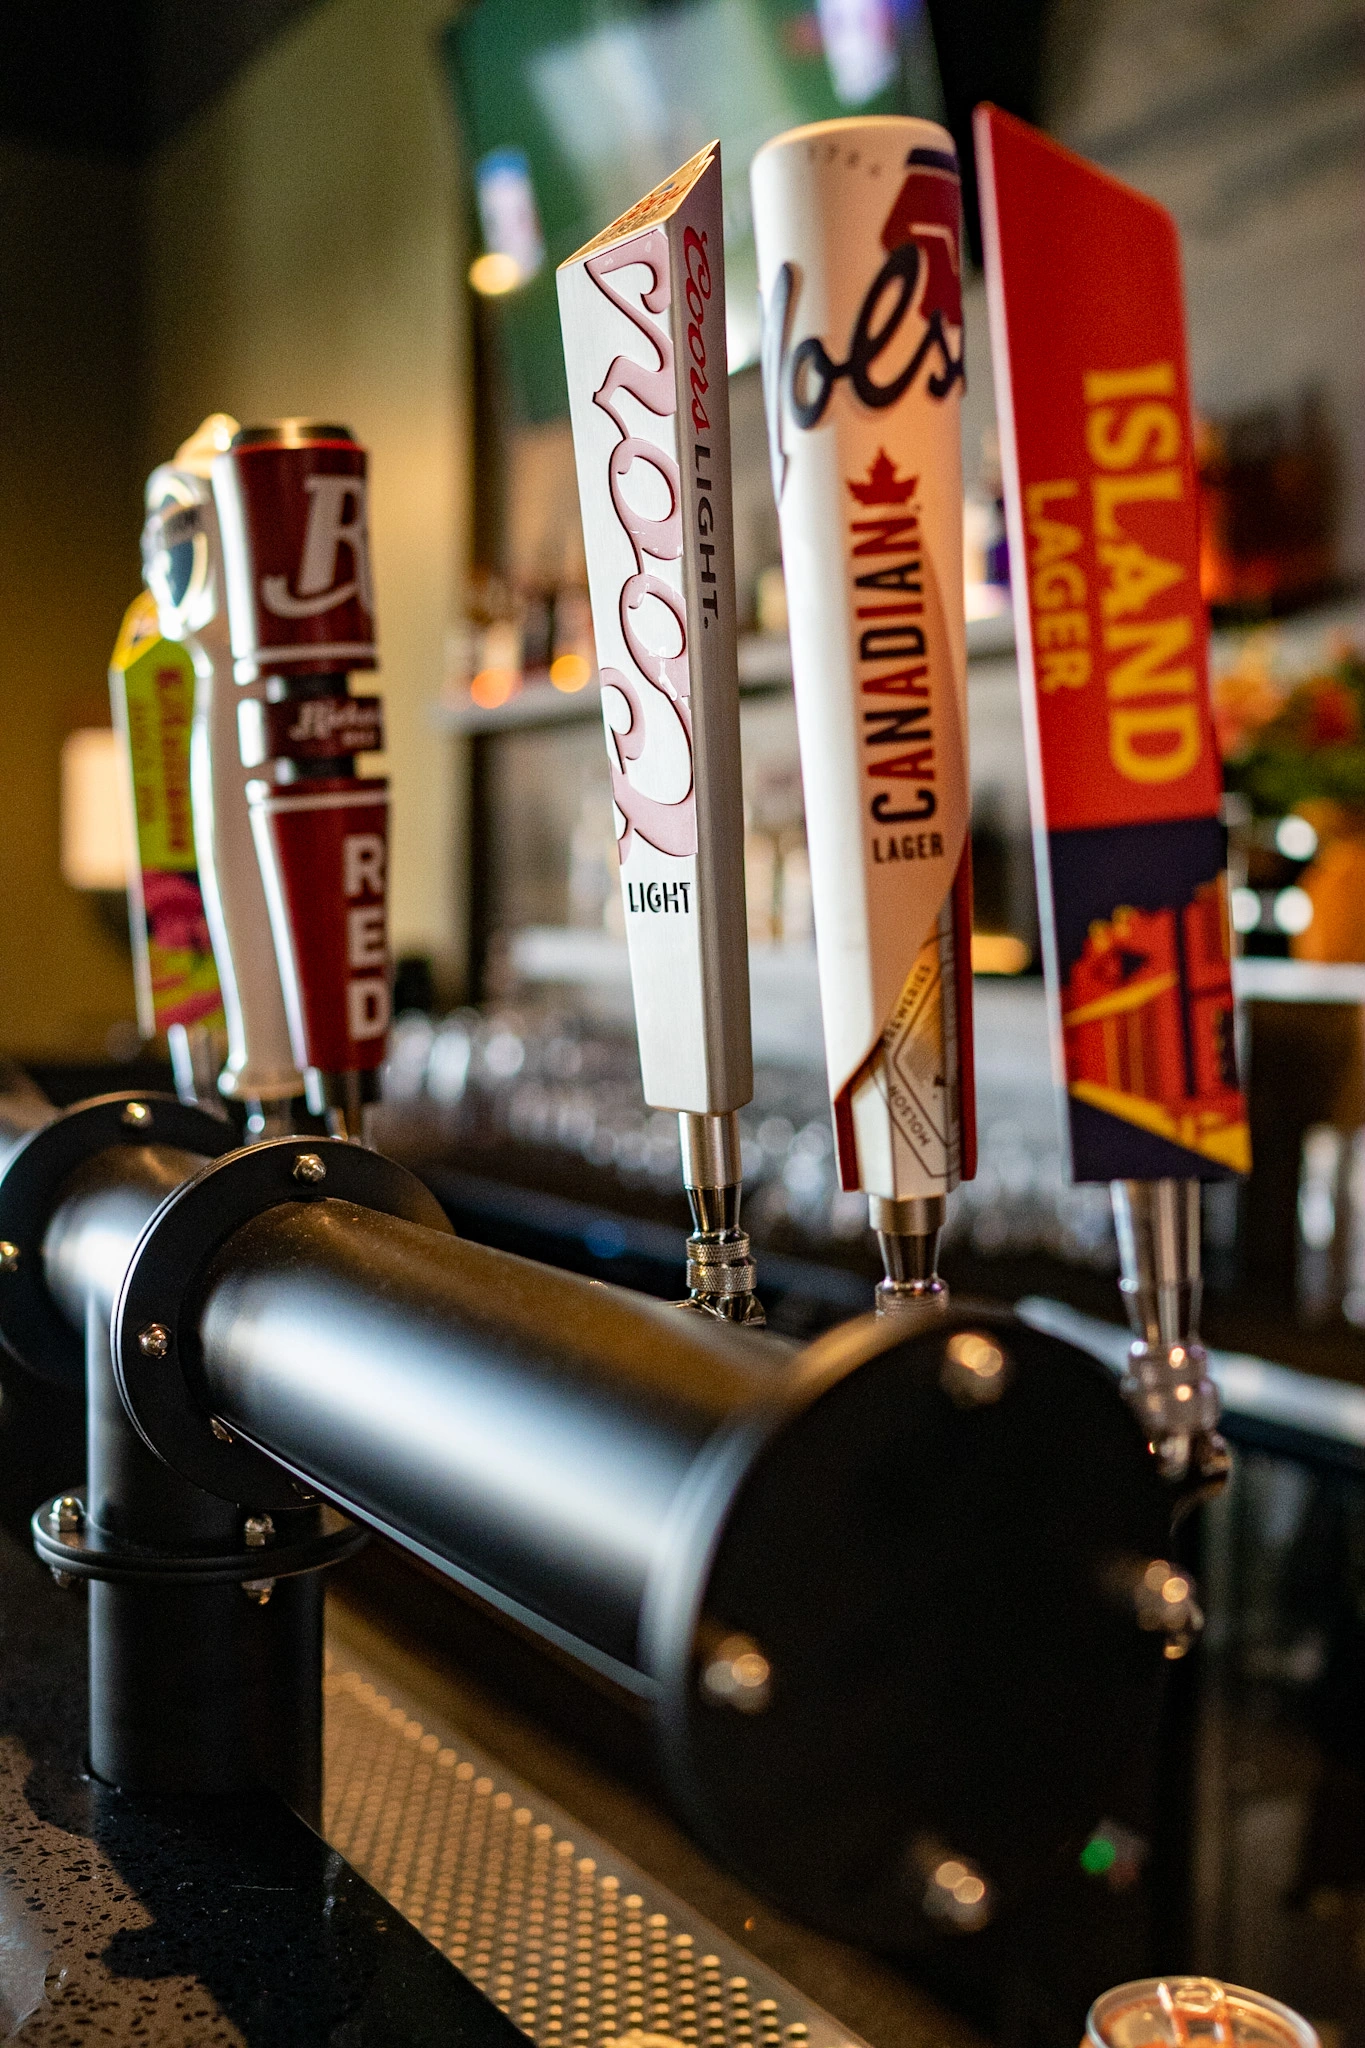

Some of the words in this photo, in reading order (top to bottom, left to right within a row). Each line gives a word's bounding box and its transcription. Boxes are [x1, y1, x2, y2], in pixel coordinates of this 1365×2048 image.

[683, 224, 712, 434] Coors
[584, 229, 699, 866] Coors
[1027, 479, 1092, 693] LAGER
[1085, 363, 1200, 783] ISLAND
[849, 517, 937, 825] CANADIAN
[343, 832, 390, 1042] RED
[628, 882, 691, 914] LIGHT
[873, 832, 944, 864] LAGER
